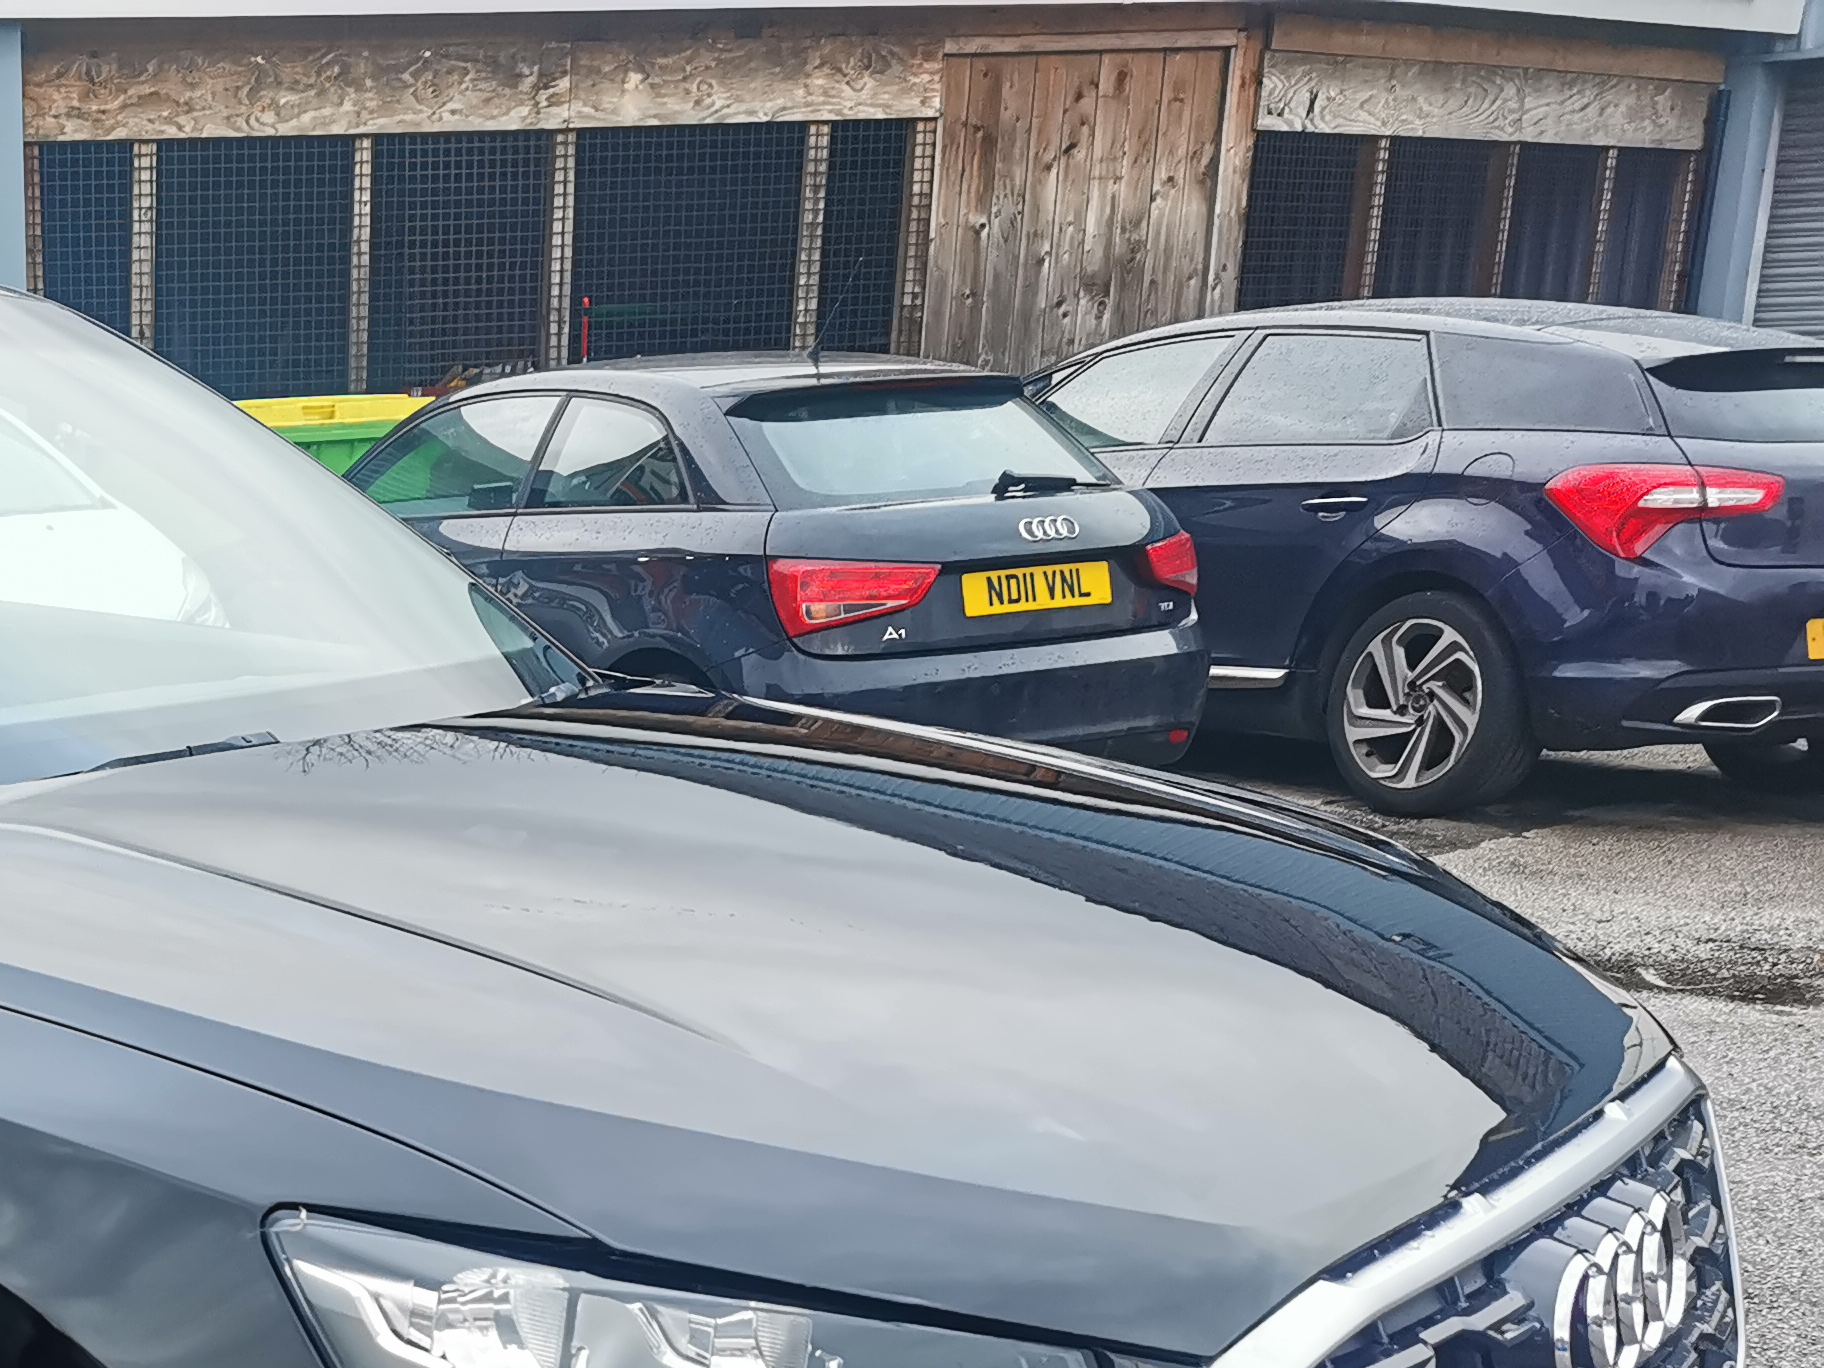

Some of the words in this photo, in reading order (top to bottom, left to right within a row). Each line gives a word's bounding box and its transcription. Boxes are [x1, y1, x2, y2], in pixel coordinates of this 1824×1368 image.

[986, 571, 1037, 607] ND11
[1043, 568, 1091, 601] VNL
[881, 625, 906, 641] A1
